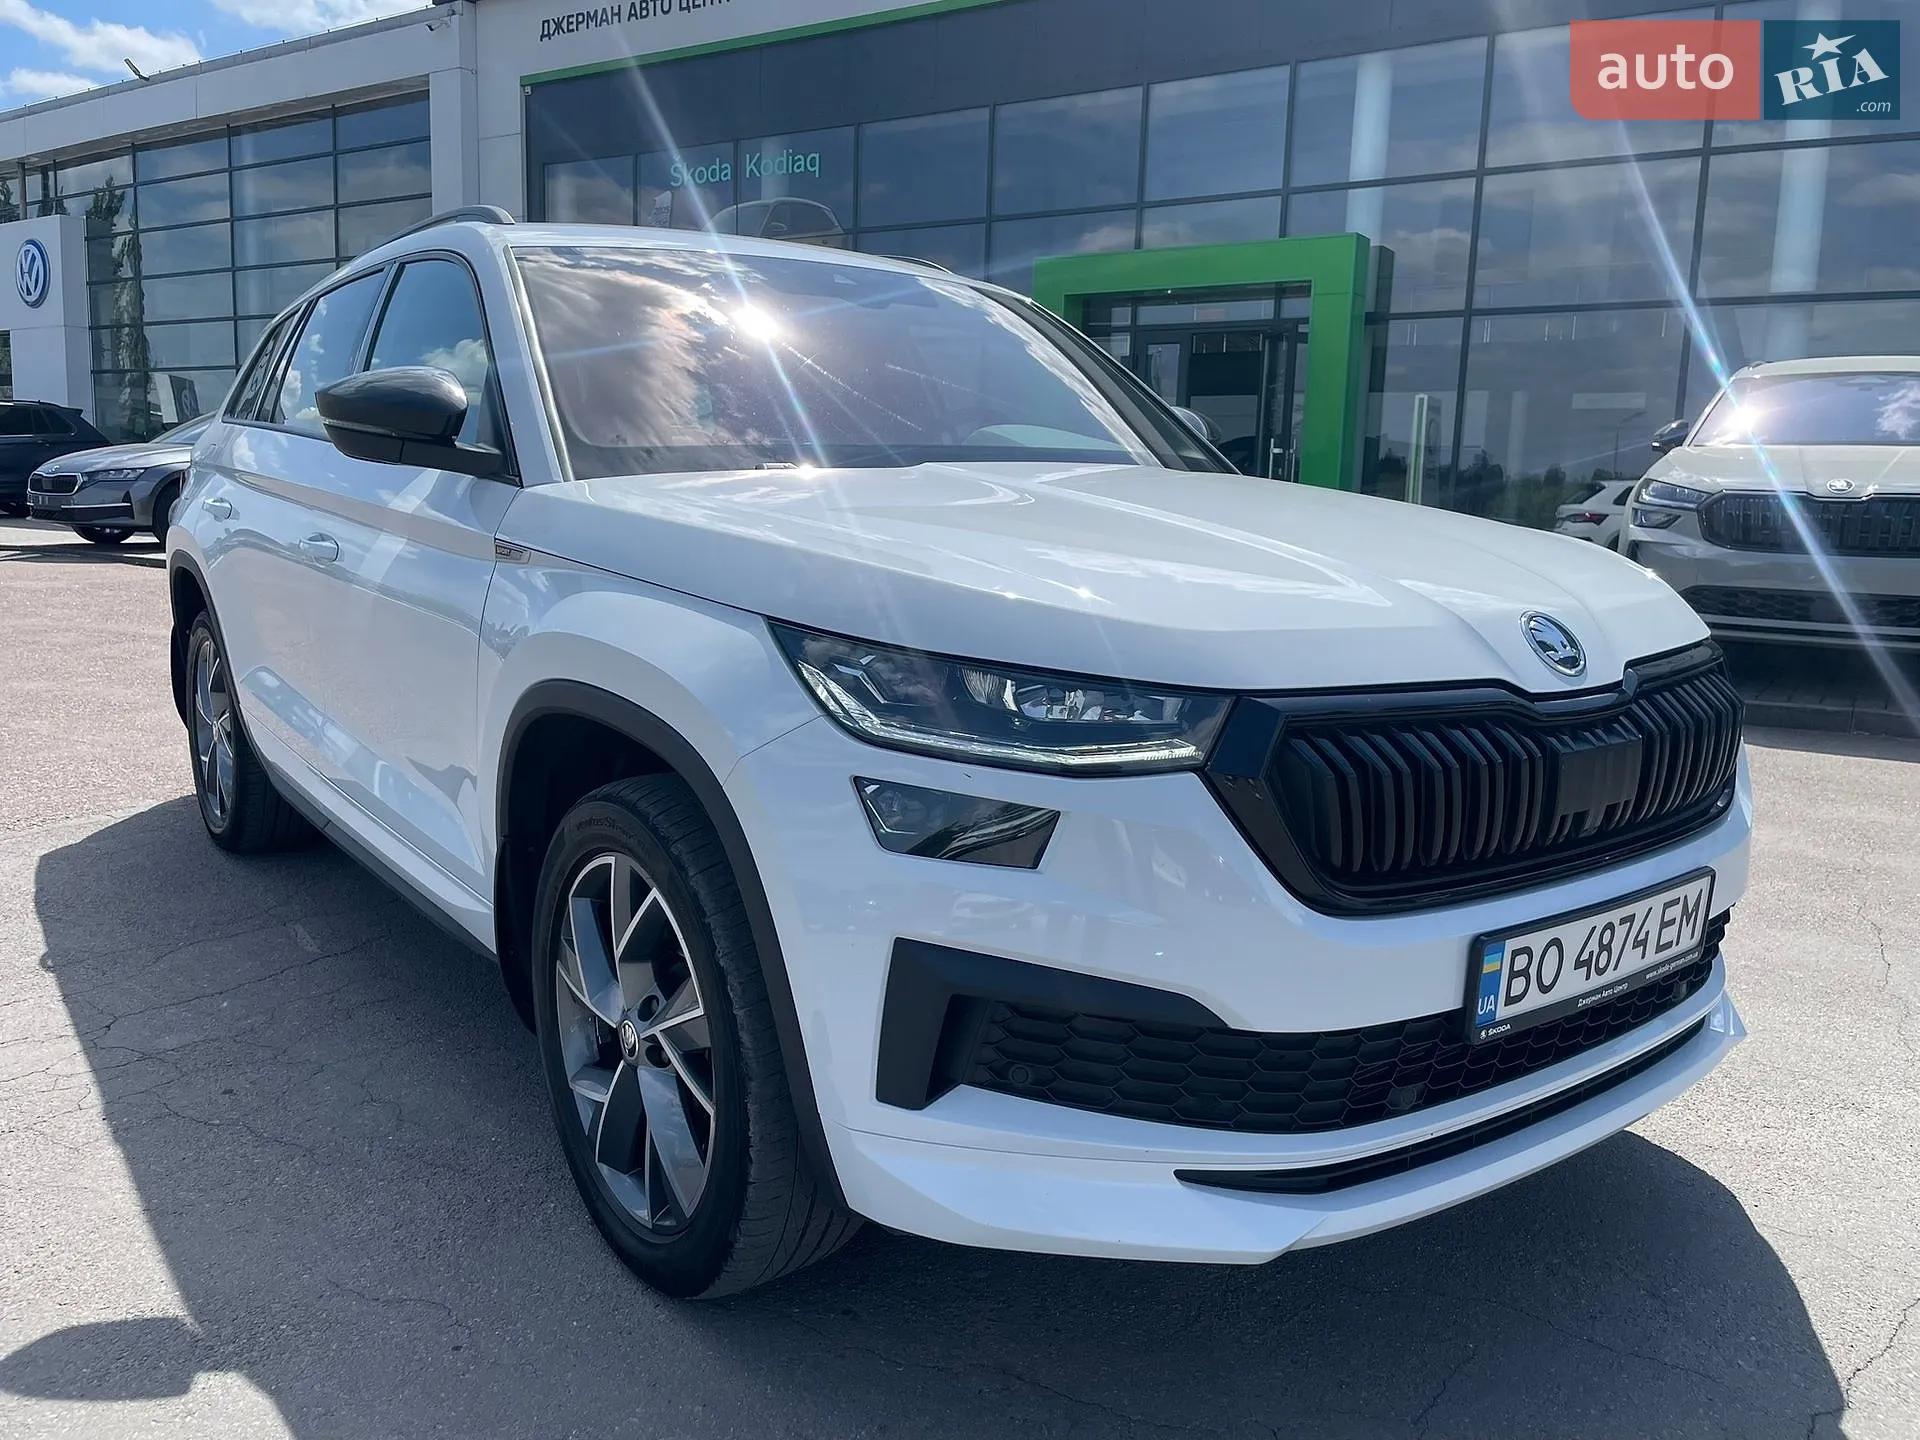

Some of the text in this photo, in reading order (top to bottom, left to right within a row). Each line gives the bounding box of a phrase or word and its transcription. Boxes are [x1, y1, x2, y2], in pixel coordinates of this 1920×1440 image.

[540, 4, 621, 42] ДЖЕРМАН
[627, 0, 672, 22] АВТО
[670, 149, 820, 187] Škoda Kodiaq
[1504, 888, 1703, 1007] BO 4874 EM
[1478, 994, 1495, 1015] UA
